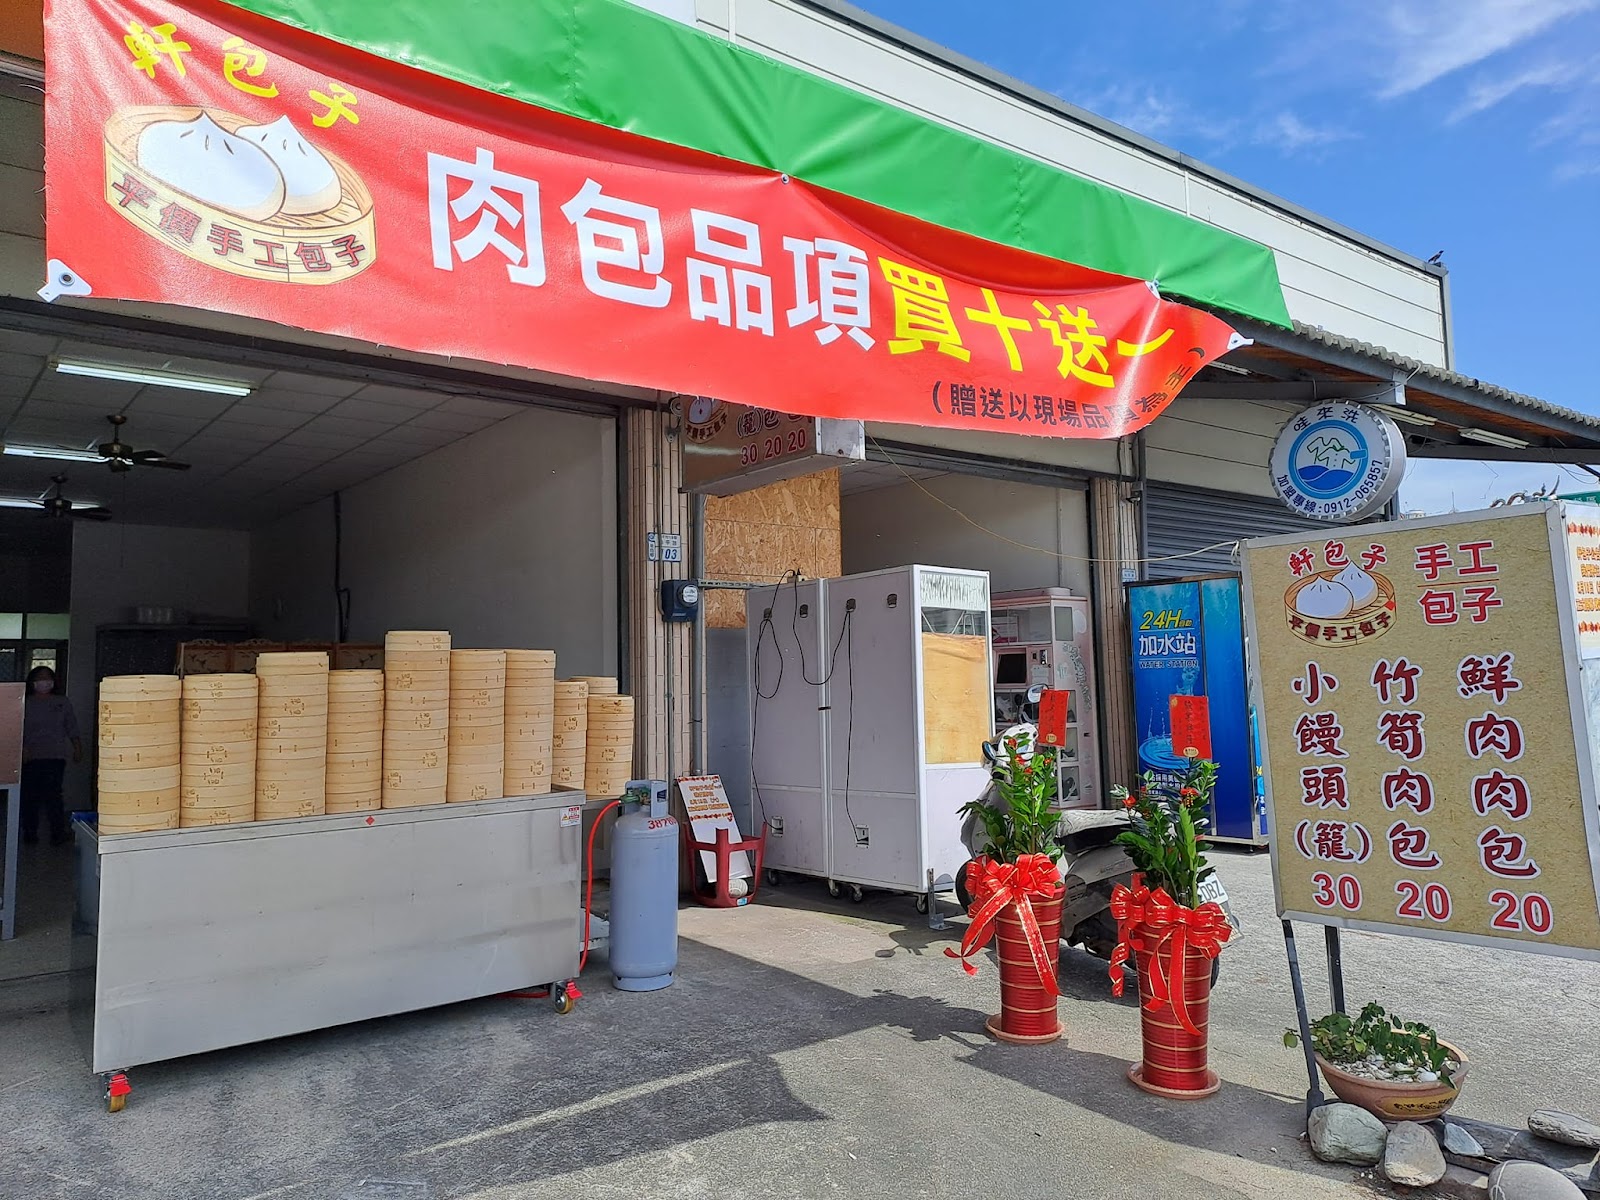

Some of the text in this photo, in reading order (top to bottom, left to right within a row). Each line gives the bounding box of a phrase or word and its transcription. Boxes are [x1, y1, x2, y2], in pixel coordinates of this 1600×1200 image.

[123, 21, 360, 128] 軒包子
[112, 173, 366, 273] 平價手工包子
[427, 146, 1175, 388] 肉包品項買十送一
[1293, 406, 1361, 432] 哇來洗
[741, 428, 806, 465] 30 20 20
[1289, 540, 1386, 577] 軒包子
[1415, 541, 1498, 580] 手工
[1140, 609, 1182, 630] 24H
[1418, 586, 1502, 625] 包子
[1138, 632, 1196, 656] 加水站
[1288, 611, 1392, 641] 平價手工包子
[1139, 659, 1199, 669] WATER STATION
[1294, 663, 1371, 863] 小饅頭(籠)
[1373, 658, 1441, 868] 竹筍肉包
[1459, 654, 1539, 877] 鮮肉肉包
[1199, 880, 1225, 901] DBZ
[1312, 872, 1363, 910] 30
[1396, 881, 1451, 921] 20
[1489, 891, 1553, 933] 20
